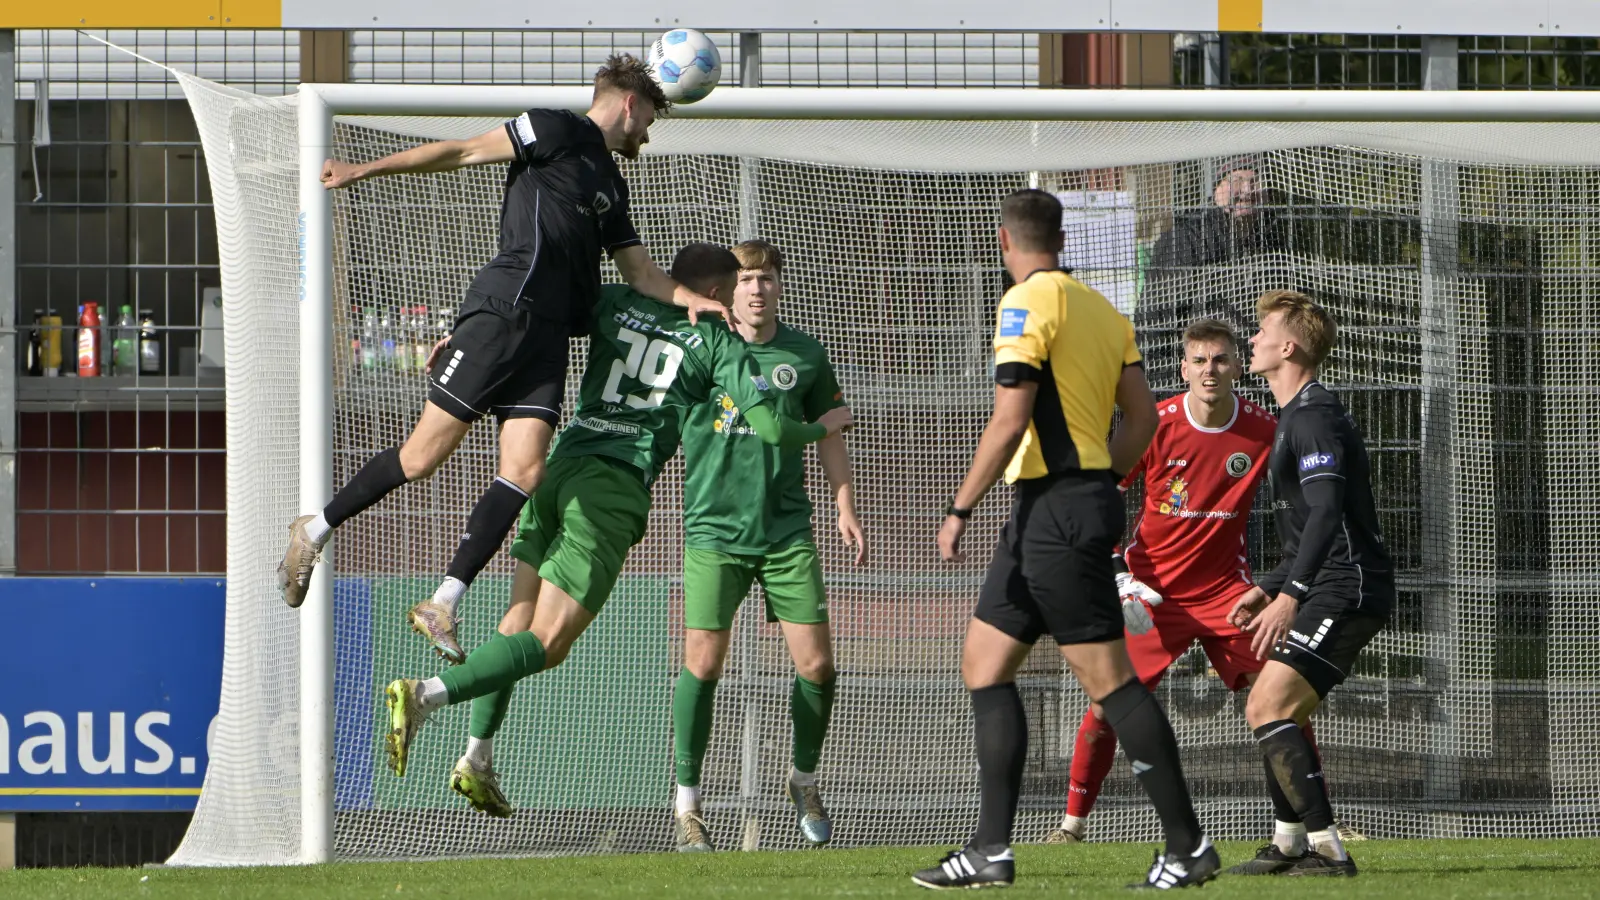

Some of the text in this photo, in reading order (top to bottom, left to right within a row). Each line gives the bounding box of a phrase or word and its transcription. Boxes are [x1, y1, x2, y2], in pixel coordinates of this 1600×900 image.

[601, 327, 684, 409] 29
[1167, 459, 1187, 467] JAKO
[0, 710, 220, 775] aus.
